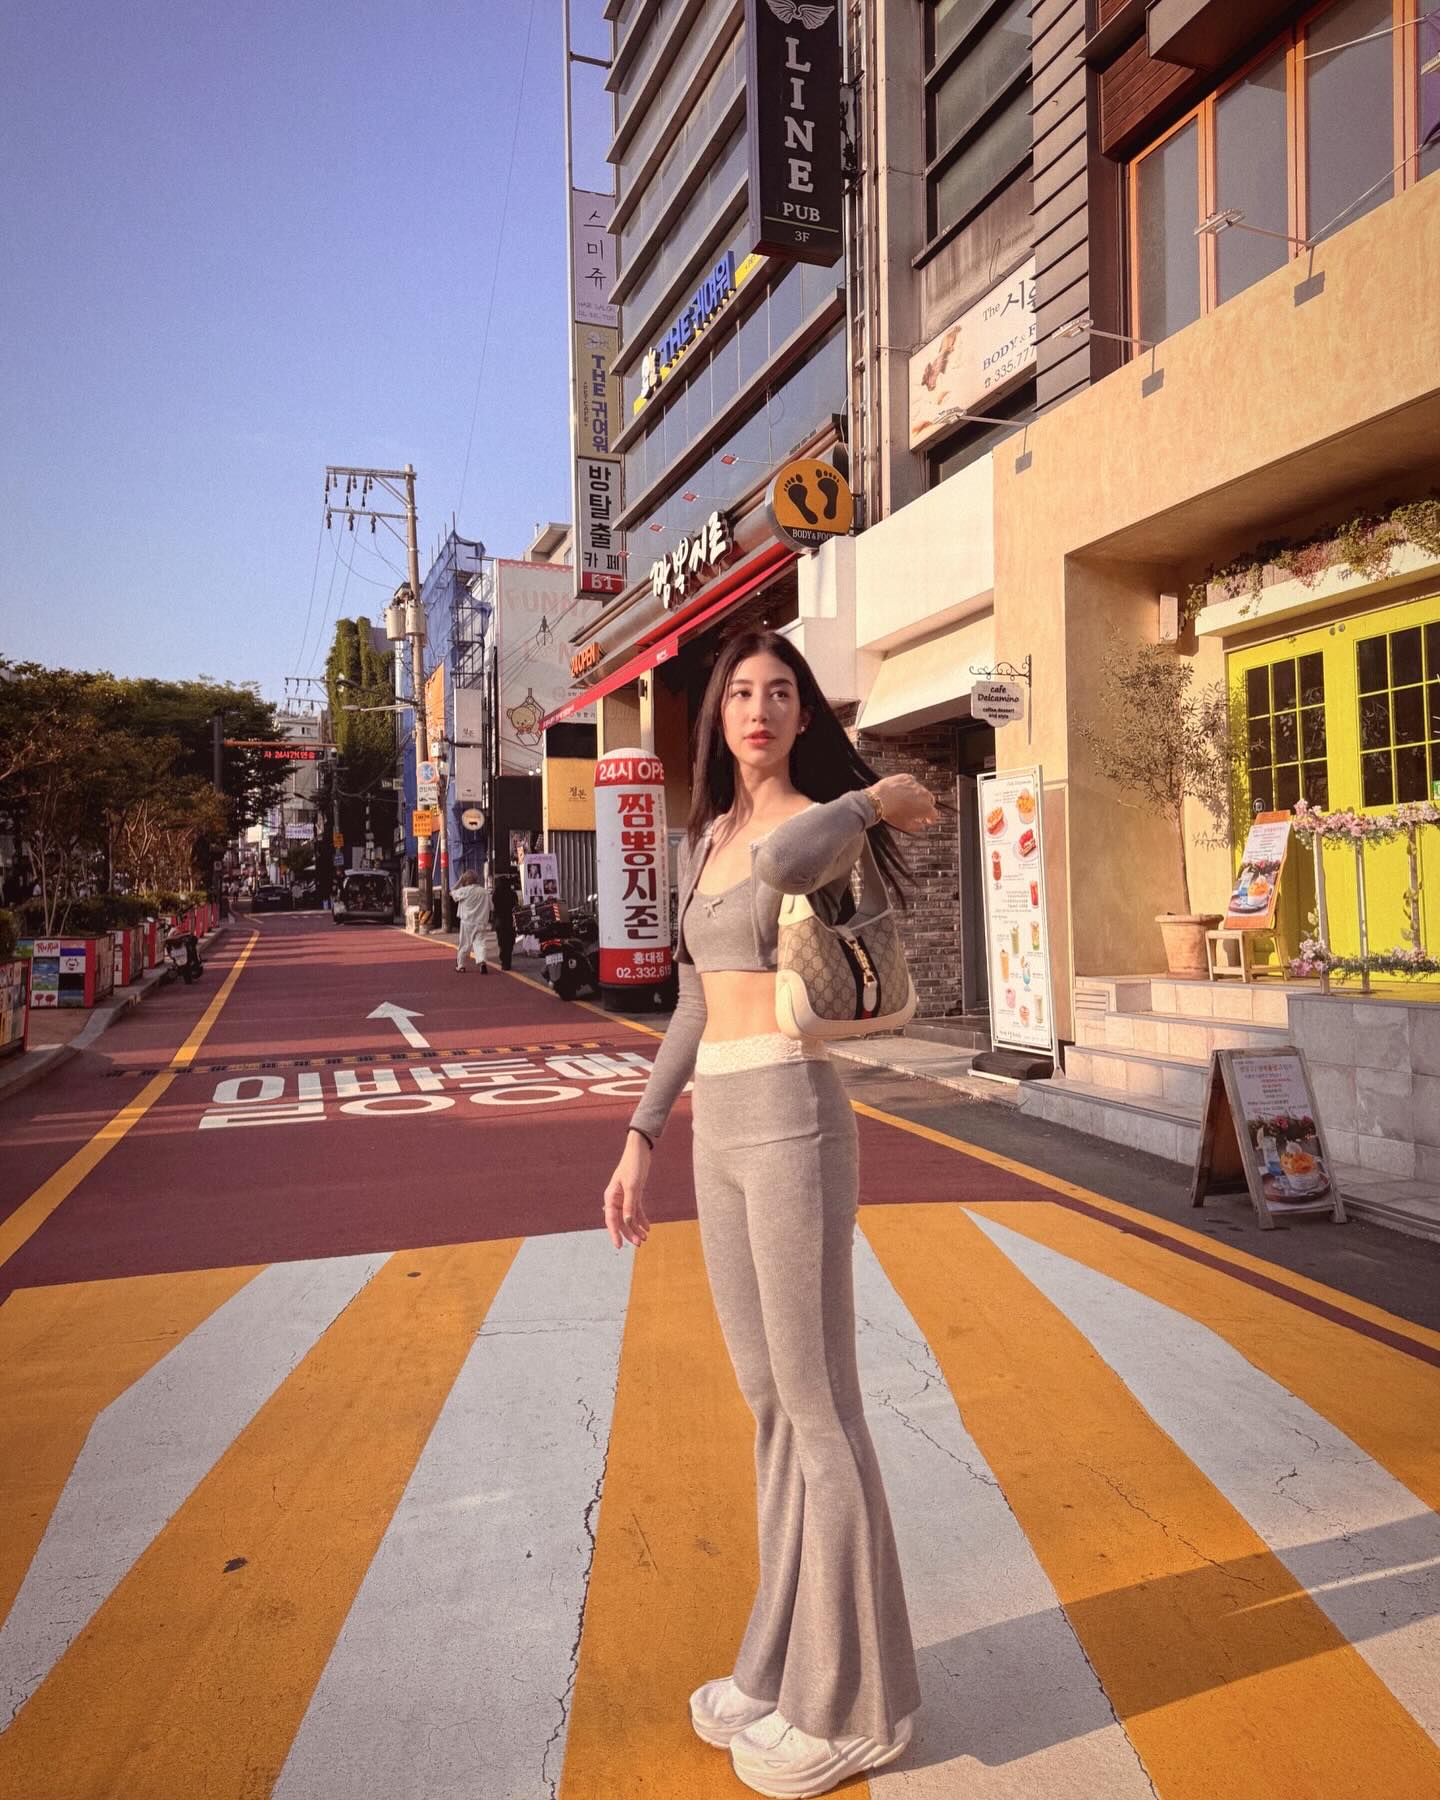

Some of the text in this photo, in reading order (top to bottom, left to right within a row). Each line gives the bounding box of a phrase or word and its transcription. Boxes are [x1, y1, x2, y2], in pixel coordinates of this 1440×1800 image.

[784, 36, 815, 193] LINE
[783, 201, 820, 222] PUB
[794, 230, 810, 242] 3F
[982, 303, 1001, 322] The
[983, 335, 1018, 370] BODY
[589, 465, 612, 550] 방탈출
[792, 528, 811, 539] BODY
[977, 693, 1020, 703] Delcamino
[990, 684, 1007, 693] cafe
[599, 761, 633, 781] 24시
[617, 793, 660, 940] 짬뽕지존
